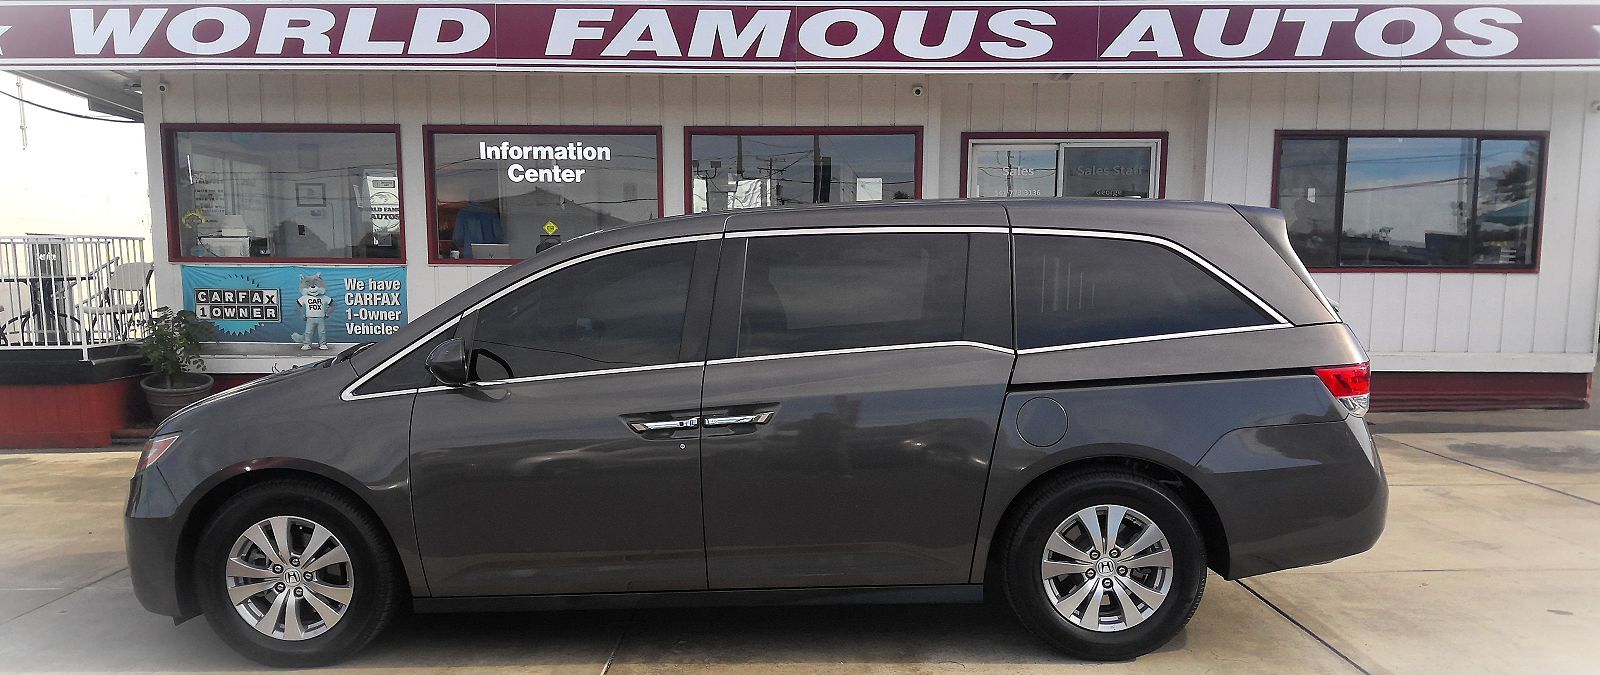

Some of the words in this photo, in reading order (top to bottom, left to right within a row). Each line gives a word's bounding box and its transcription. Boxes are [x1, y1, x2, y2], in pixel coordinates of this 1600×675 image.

[69, 7, 491, 56] WORLD
[544, 8, 1057, 59] FAMOUS
[1100, 7, 1523, 59] AUTOS
[479, 141, 611, 161] Information
[507, 163, 586, 183] Center
[1002, 166, 1034, 176] Sales
[1077, 165, 1110, 177] Sales
[1112, 165, 1144, 177] Staff
[344, 278, 365, 291] We
[368, 278, 401, 291] have
[197, 292, 275, 304] CARFAX
[344, 292, 401, 306] CARFAX
[345, 307, 401, 321] 1-Owner
[345, 322, 400, 335] Vehicles
